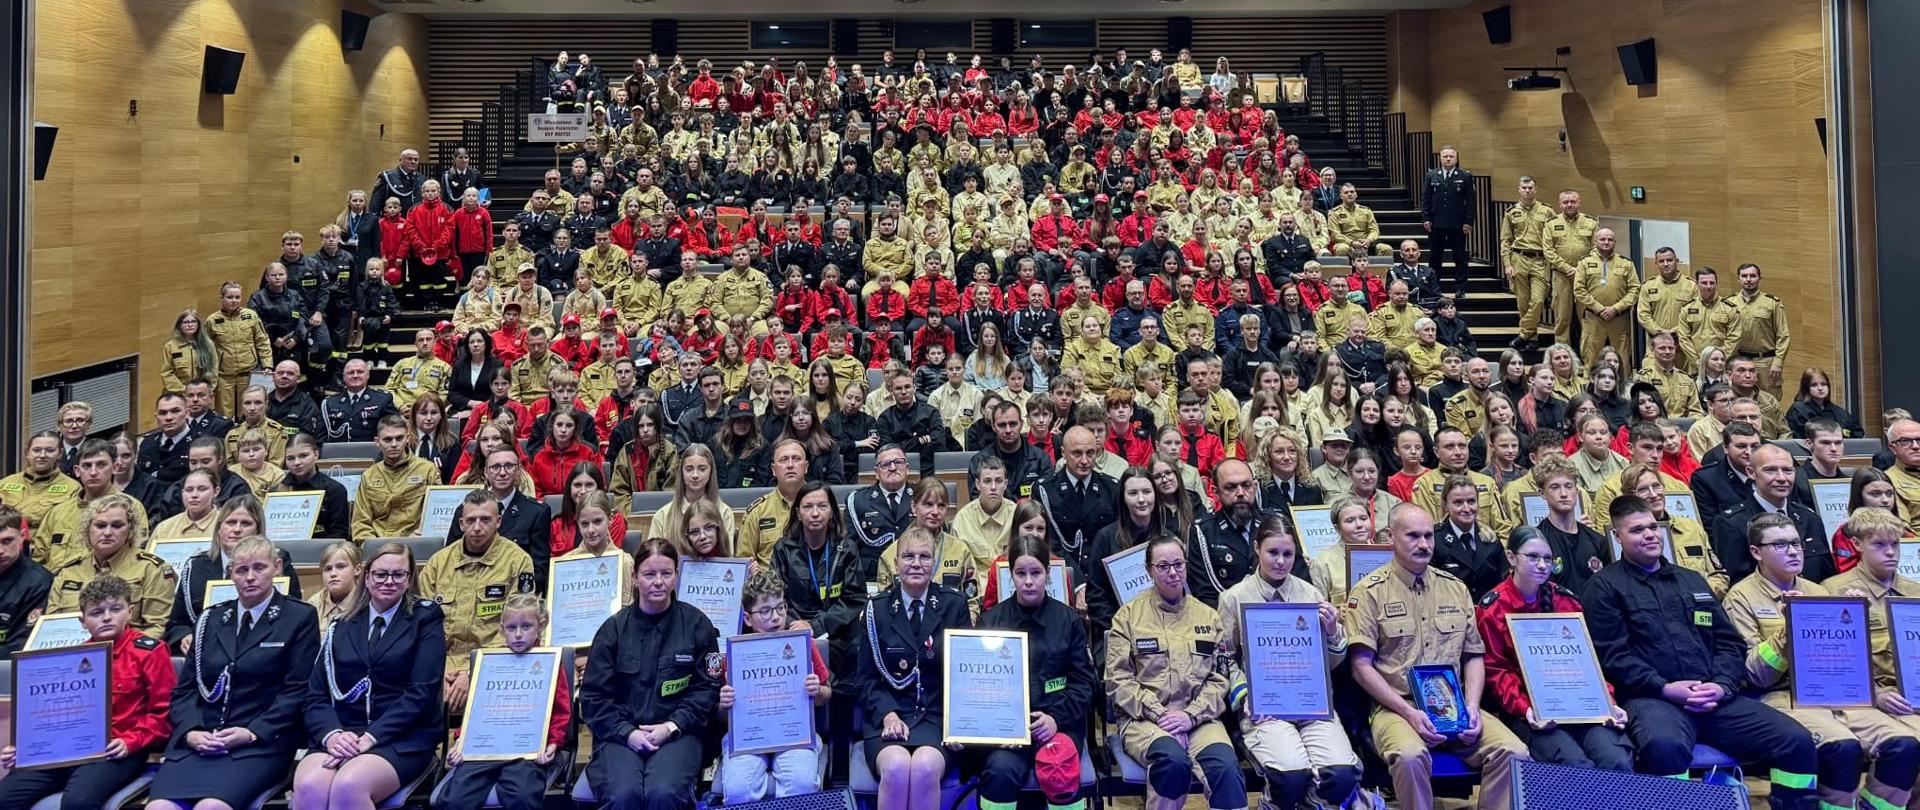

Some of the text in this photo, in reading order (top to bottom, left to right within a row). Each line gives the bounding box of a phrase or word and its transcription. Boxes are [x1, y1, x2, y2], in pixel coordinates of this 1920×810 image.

[432, 507, 454, 515] DYPL
[1825, 503, 1849, 511] DYPL
[269, 511, 310, 520] DYPLOM
[1305, 527, 1336, 536] DYPLO
[944, 559, 959, 568] OSP
[561, 578, 611, 592] DYPLOM
[1124, 574, 1152, 591] DYPL
[687, 585, 736, 596] DYPLOM
[481, 604, 504, 612] STRA
[1700, 615, 1713, 623] STR
[1194, 625, 1212, 634] OSP
[1801, 628, 1857, 640] DYPLOM
[40, 638, 84, 649] DYPLO
[1257, 636, 1313, 647] DYPLOM
[1528, 644, 1582, 655] DYPLOM
[742, 664, 799, 680] DYPLOM
[959, 662, 1015, 675] DYPLOM
[29, 678, 96, 696] DYPLOM
[485, 679, 543, 691] DYPLOM
